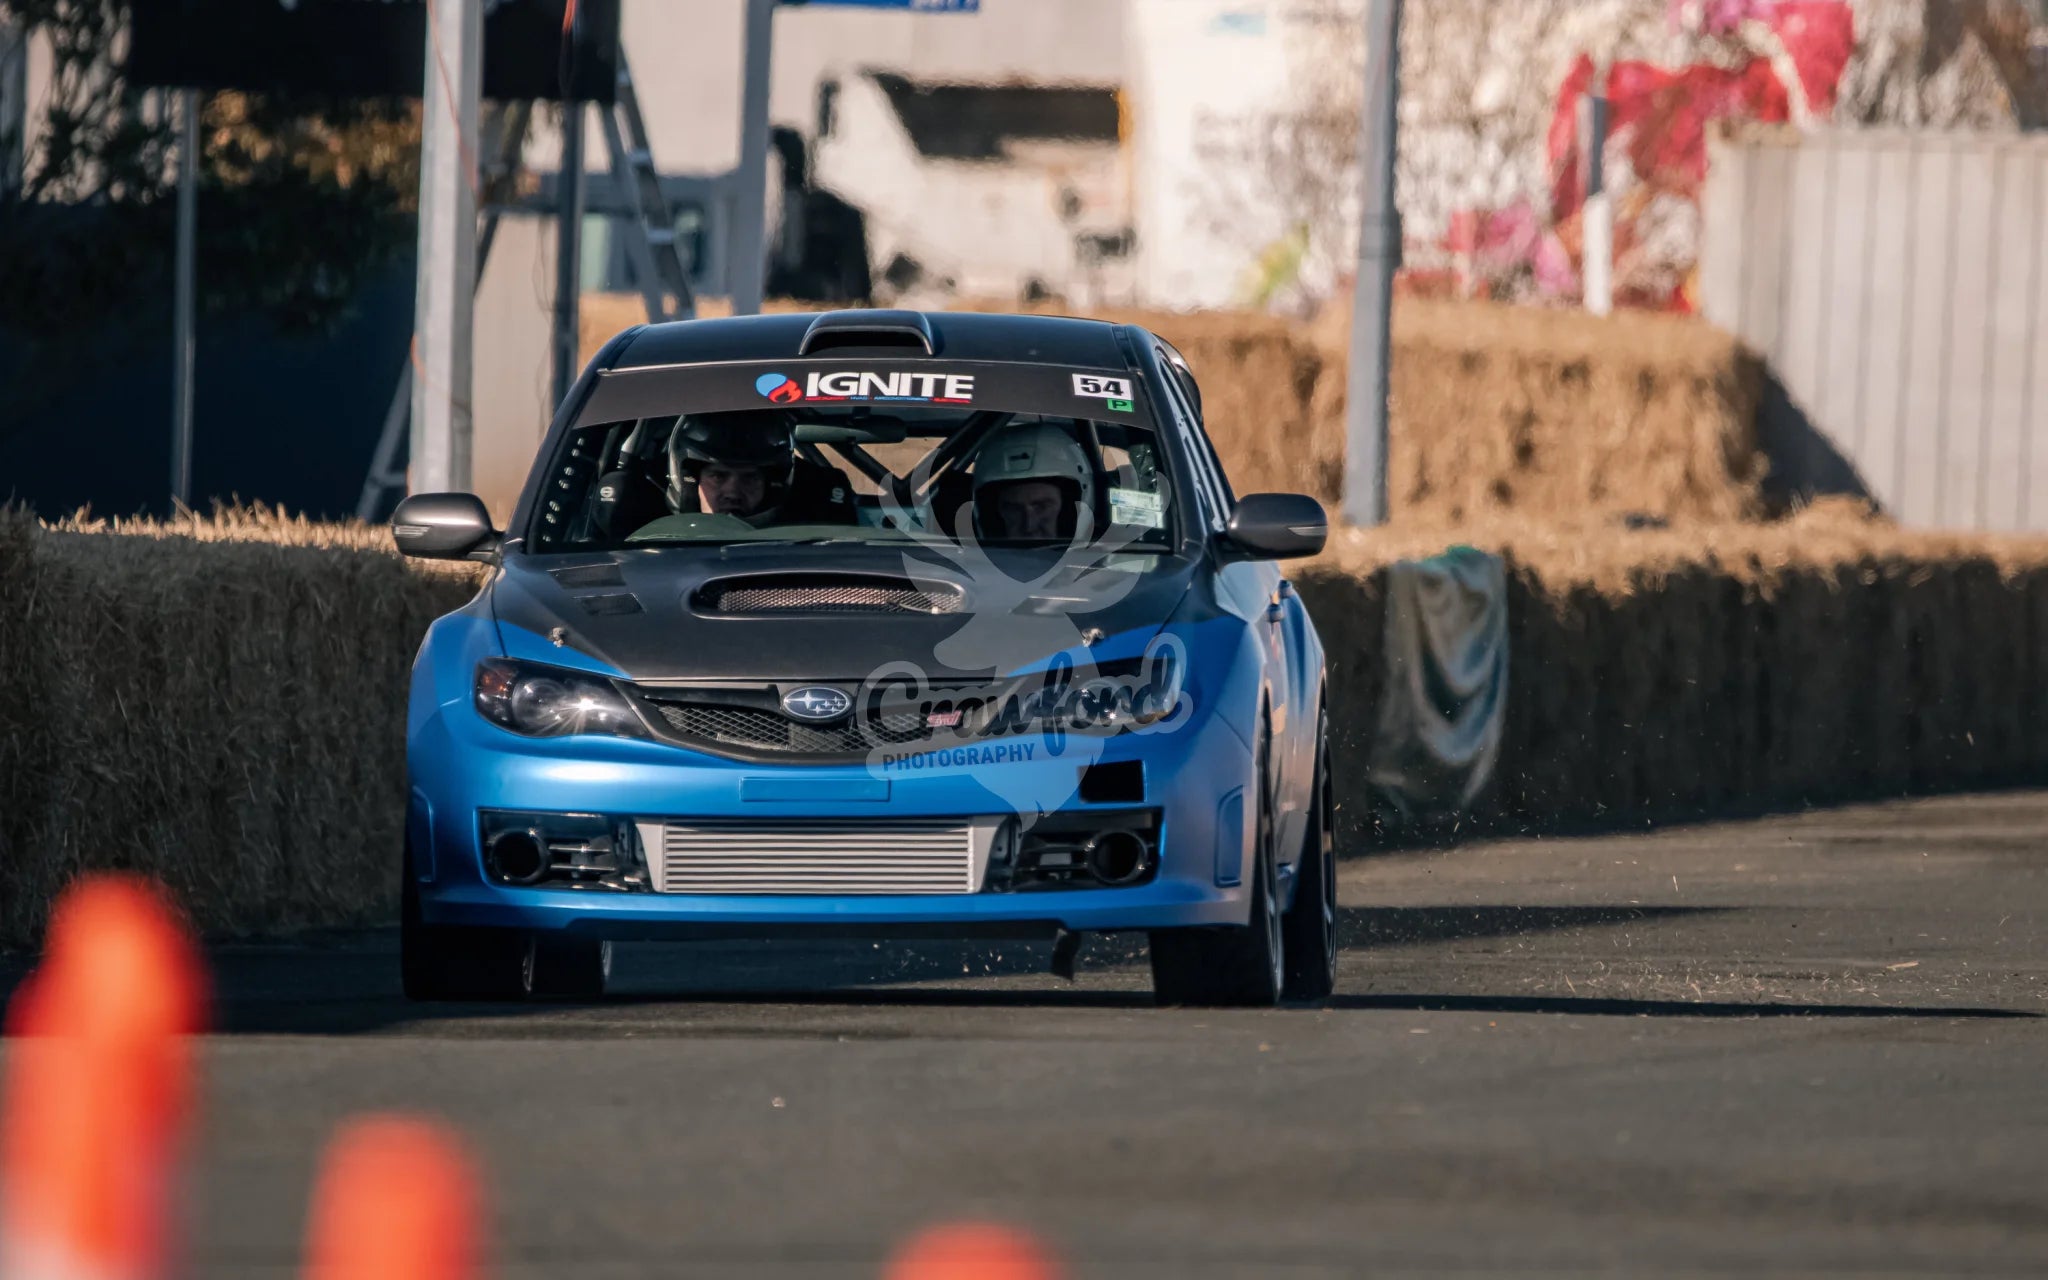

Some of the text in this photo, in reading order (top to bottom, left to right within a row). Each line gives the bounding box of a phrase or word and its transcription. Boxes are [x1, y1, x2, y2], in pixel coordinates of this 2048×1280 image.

[805, 372, 975, 400] IGNITE
[1080, 377, 1124, 397] 54
[1112, 400, 1128, 409] P
